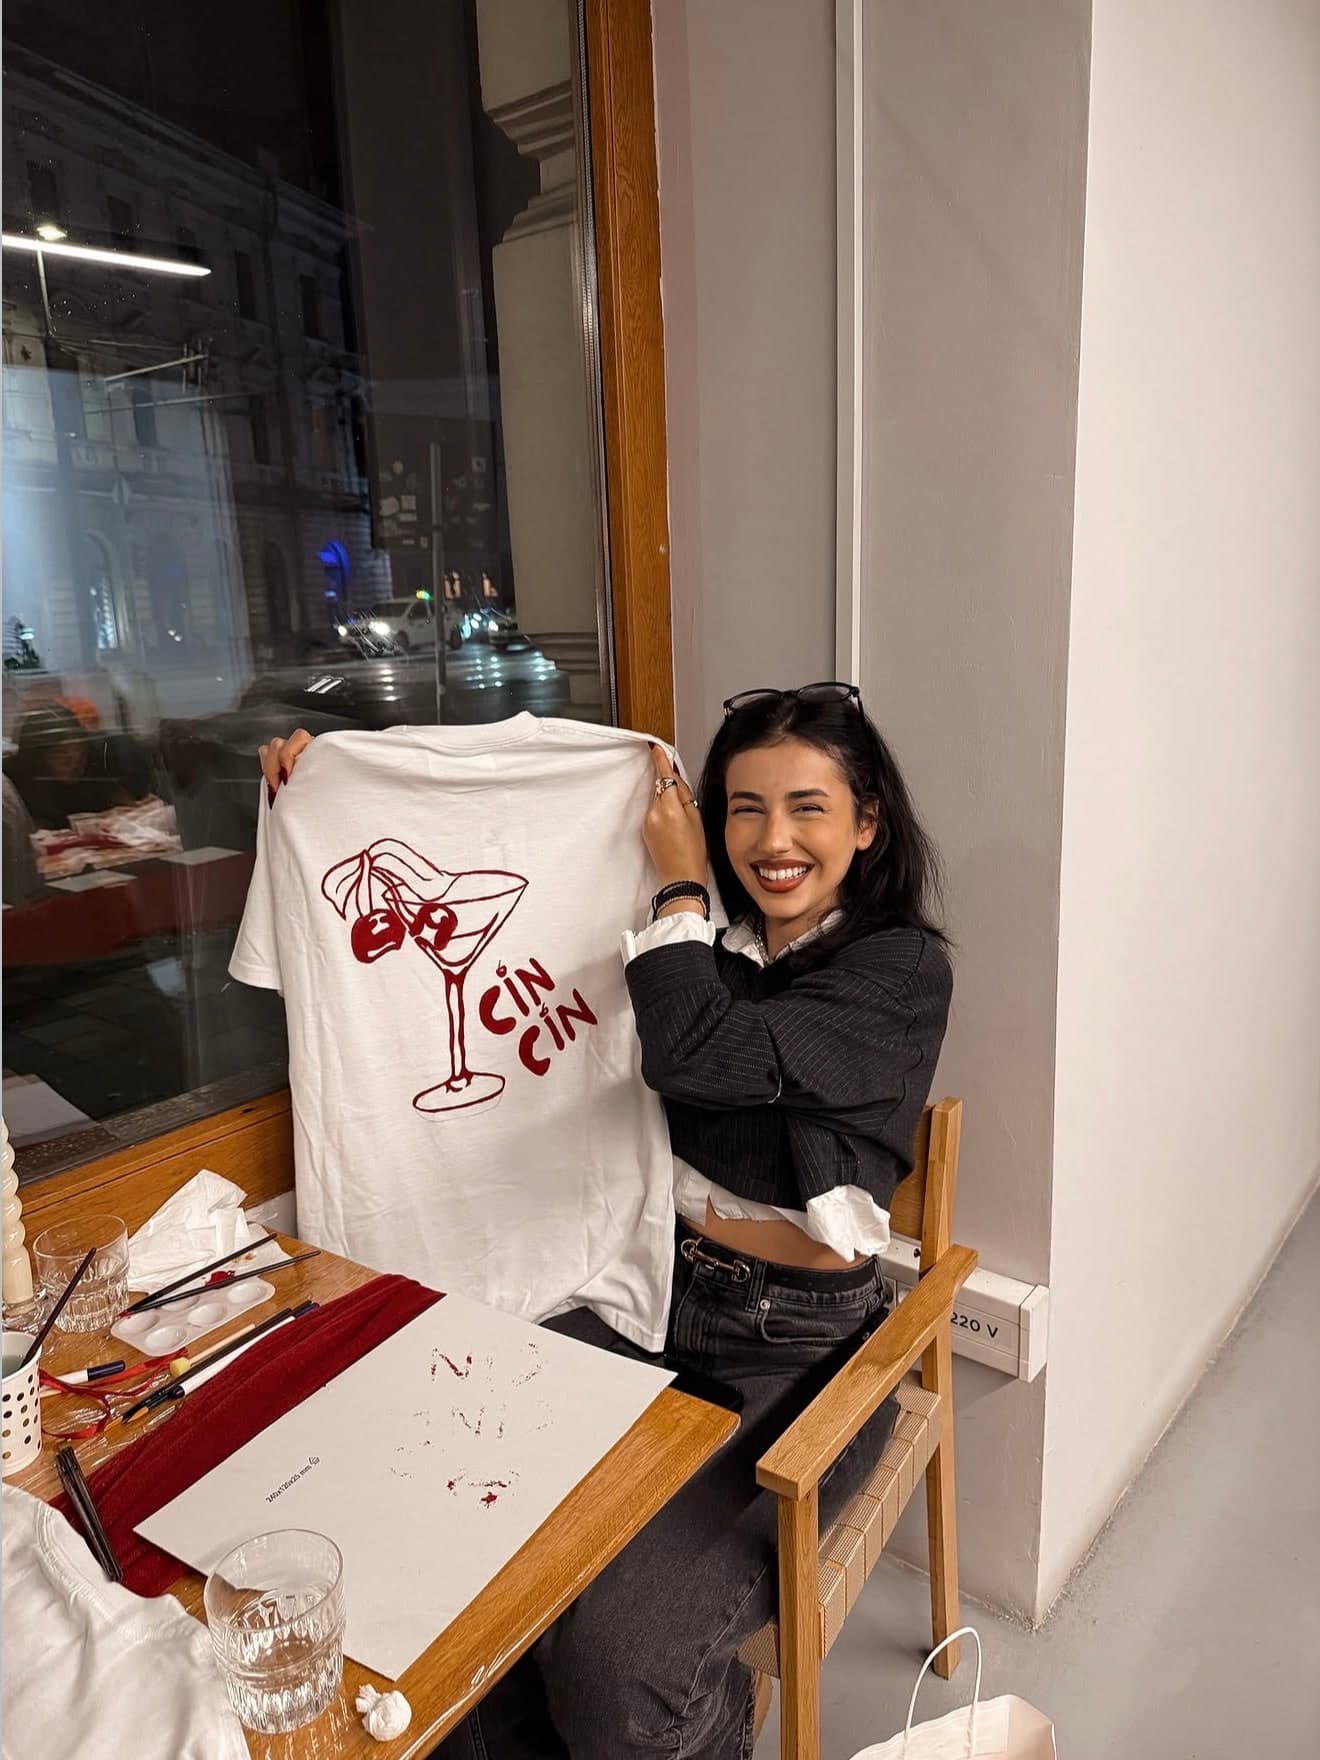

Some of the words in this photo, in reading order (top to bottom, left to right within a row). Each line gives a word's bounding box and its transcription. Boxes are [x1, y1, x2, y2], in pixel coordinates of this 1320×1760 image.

[950, 1311, 981, 1332] 220
[986, 1323, 999, 1339] V
[299, 1464, 312, 1476] mm
